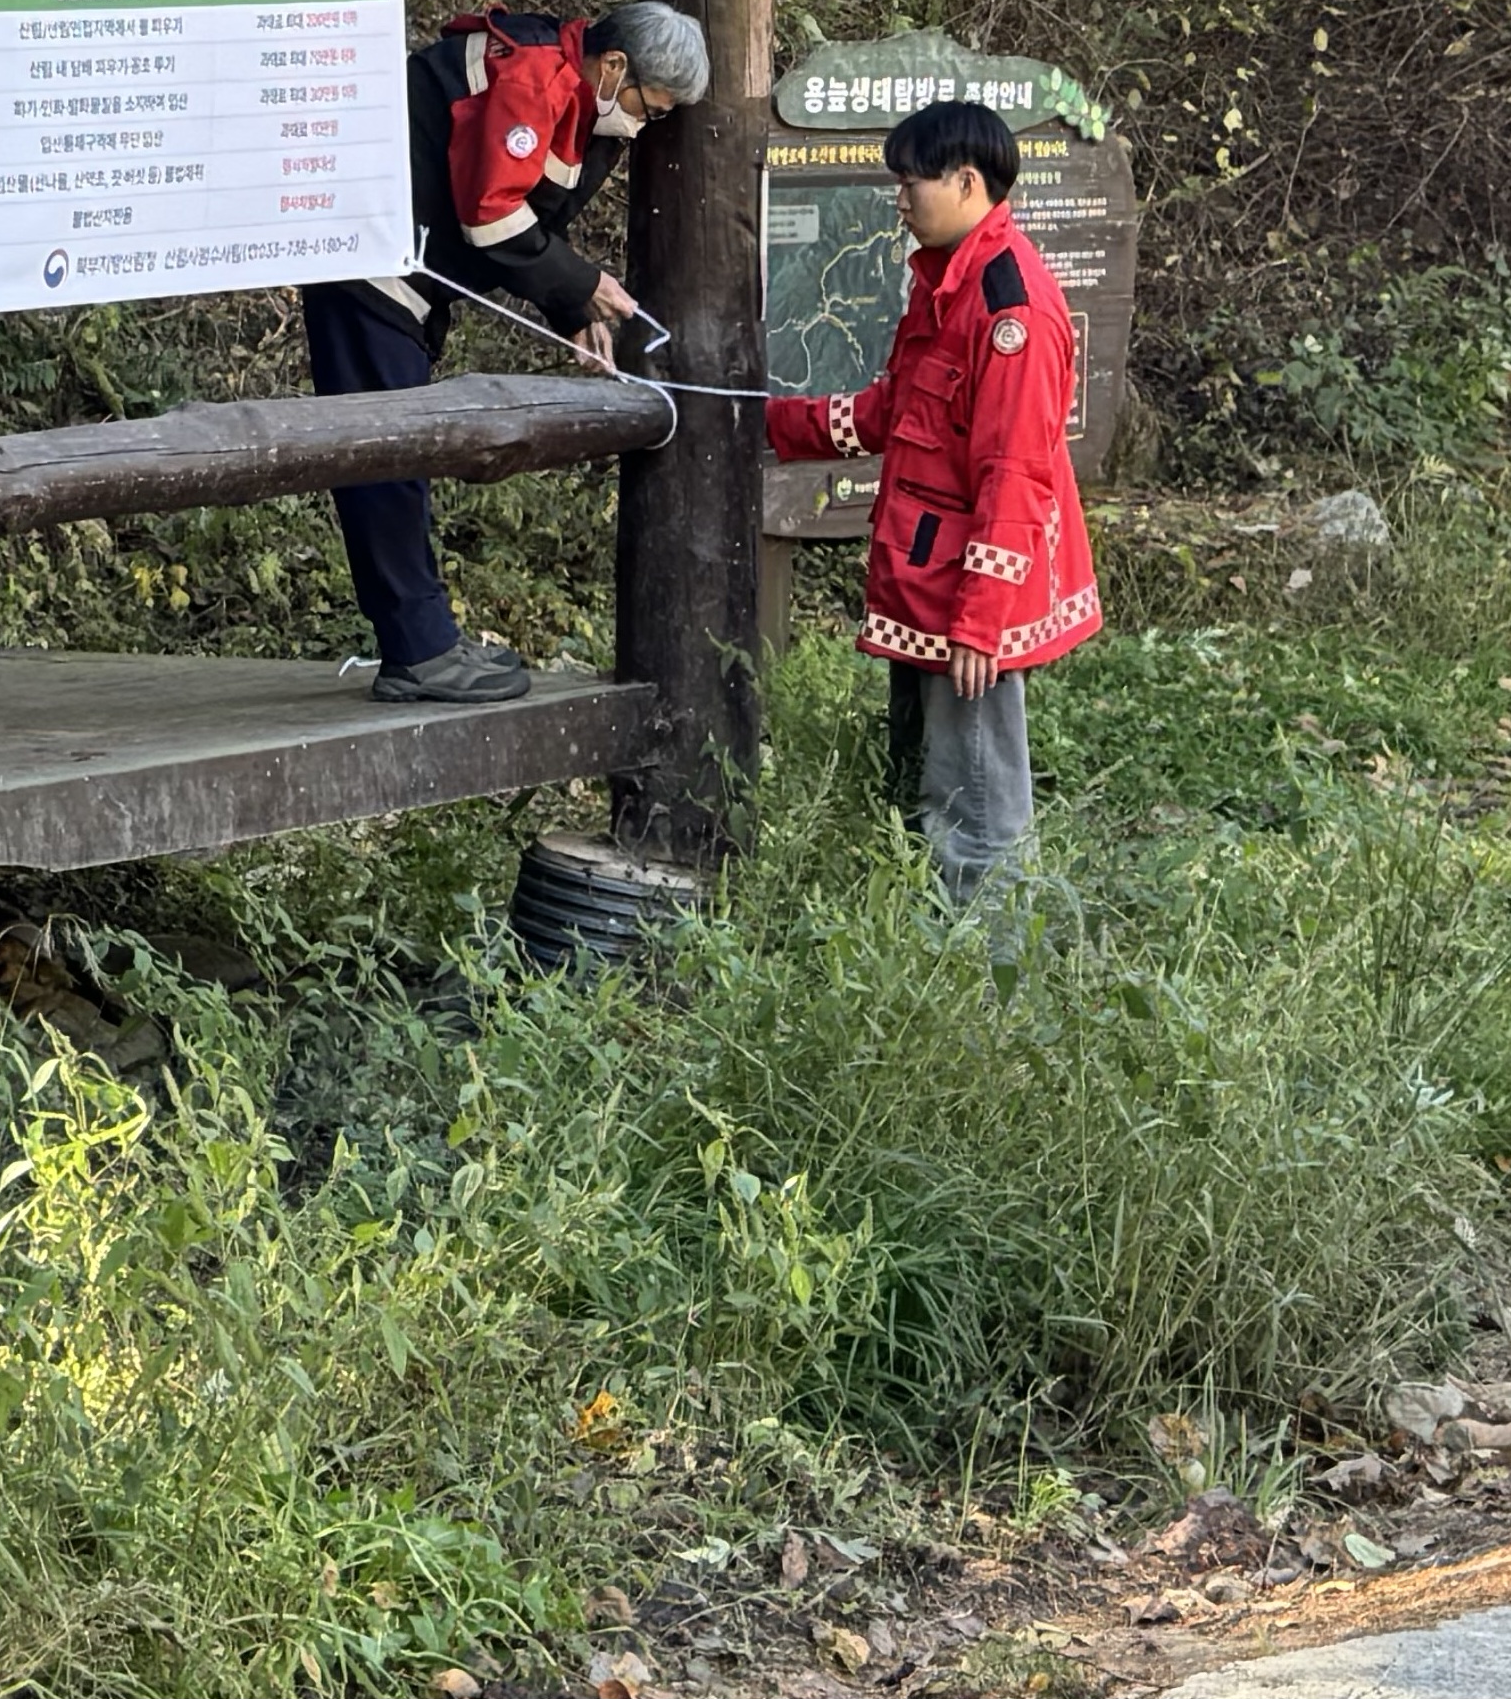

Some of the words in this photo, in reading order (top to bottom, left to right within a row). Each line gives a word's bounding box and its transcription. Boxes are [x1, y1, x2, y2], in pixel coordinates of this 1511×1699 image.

[151, 16, 183, 35] 피우기
[30, 60, 53, 79] 산림
[56, 60, 67, 76] 내
[70, 58, 92, 78] 담배
[154, 55, 175, 74] 투기
[168, 93, 188, 111] 입산
[120, 132, 140, 149] 무단
[143, 130, 164, 148] 입산
[72, 206, 133, 229] 불법산지전용
